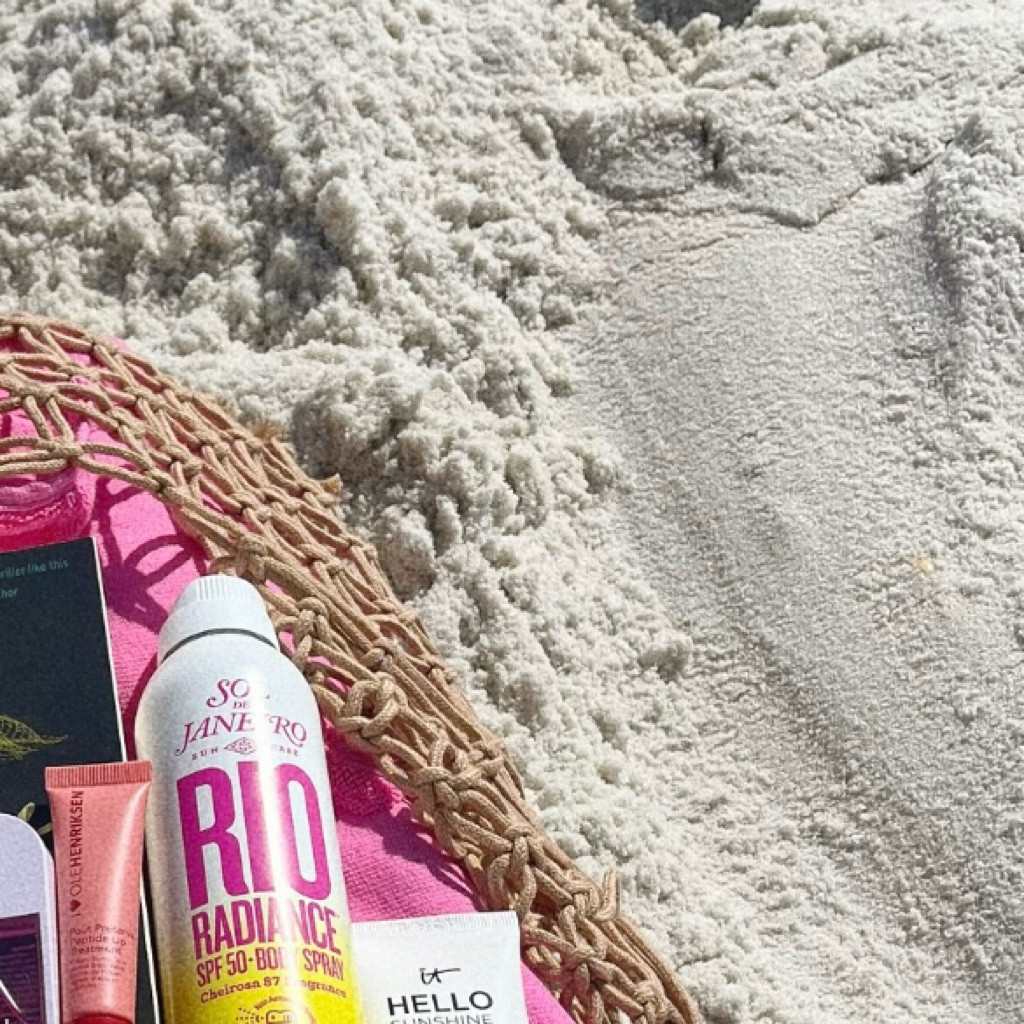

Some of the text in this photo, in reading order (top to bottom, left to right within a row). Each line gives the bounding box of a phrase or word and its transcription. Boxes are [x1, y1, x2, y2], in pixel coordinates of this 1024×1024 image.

[27, 562, 47, 575] like
[48, 559, 69, 570] this
[206, 678, 270, 708] SO
[175, 712, 307, 756] JANERO
[176, 761, 331, 911] RIO
[192, 897, 342, 960] RADIANCE
[196, 955, 222, 988] SPF
[302, 947, 345, 981] SPRAY
[200, 979, 261, 1004] Cheirosa
[263, 975, 281, 987] 87
[386, 990, 494, 1016] HELLO
